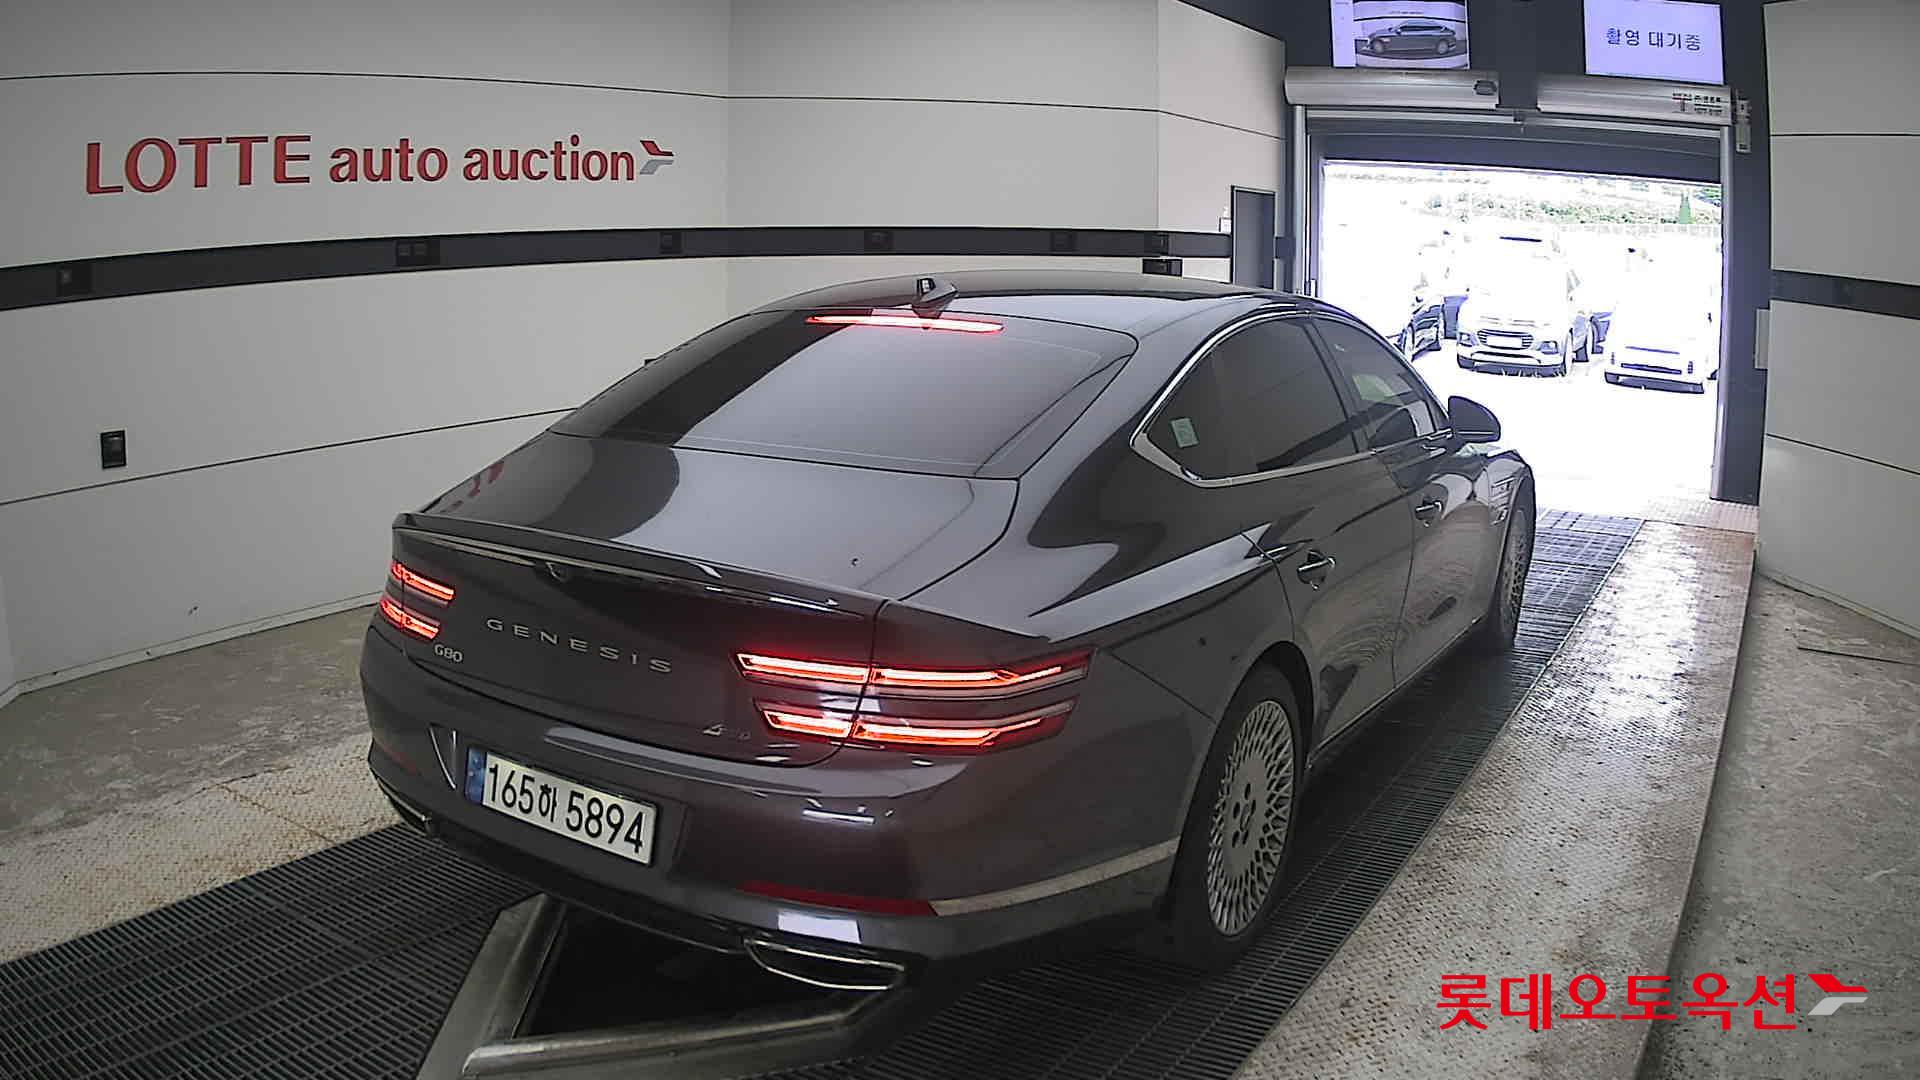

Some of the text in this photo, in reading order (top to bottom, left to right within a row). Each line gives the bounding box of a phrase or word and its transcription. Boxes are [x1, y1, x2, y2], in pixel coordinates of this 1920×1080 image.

[1648, 31, 1702, 52] 대기중
[86, 134, 635, 195] LOTTE auto auction
[433, 644, 464, 664] G80
[486, 617, 673, 674] GENESIS
[488, 763, 646, 854] 165하 5894
